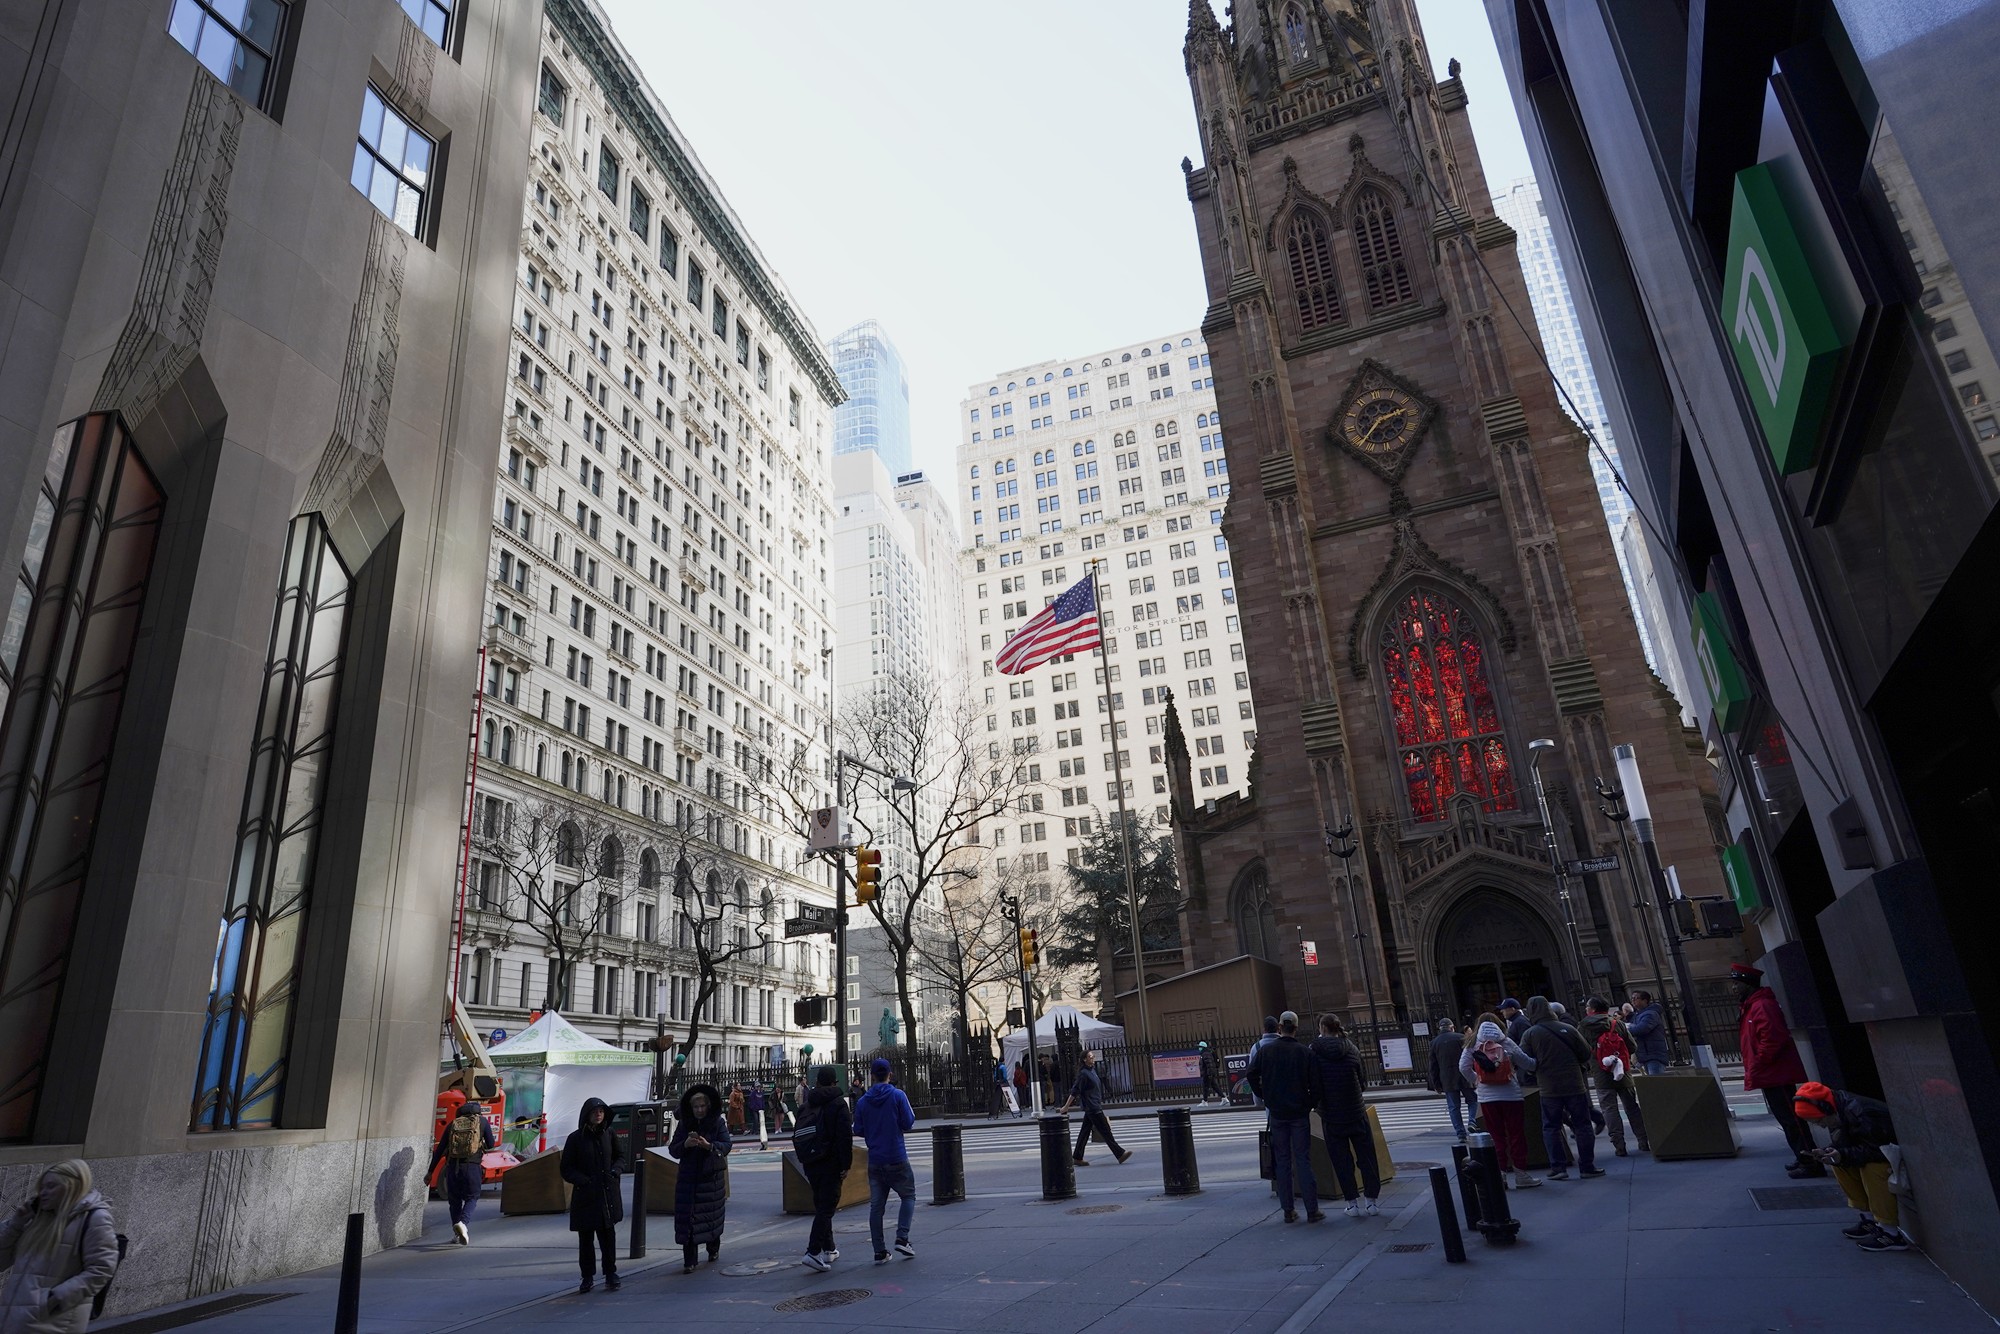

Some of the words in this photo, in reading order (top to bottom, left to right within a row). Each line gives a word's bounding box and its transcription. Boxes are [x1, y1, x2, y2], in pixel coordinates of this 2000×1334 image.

[1735, 247, 1786, 408] TD
[1149, 614, 1191, 627] STREET
[1583, 861, 1615, 870] Broadway
[804, 908, 817, 920] Wall
[788, 923, 816, 933] Broadway
[578, 1054, 593, 1063] PCR
[1228, 1060, 1246, 1069] GEO
